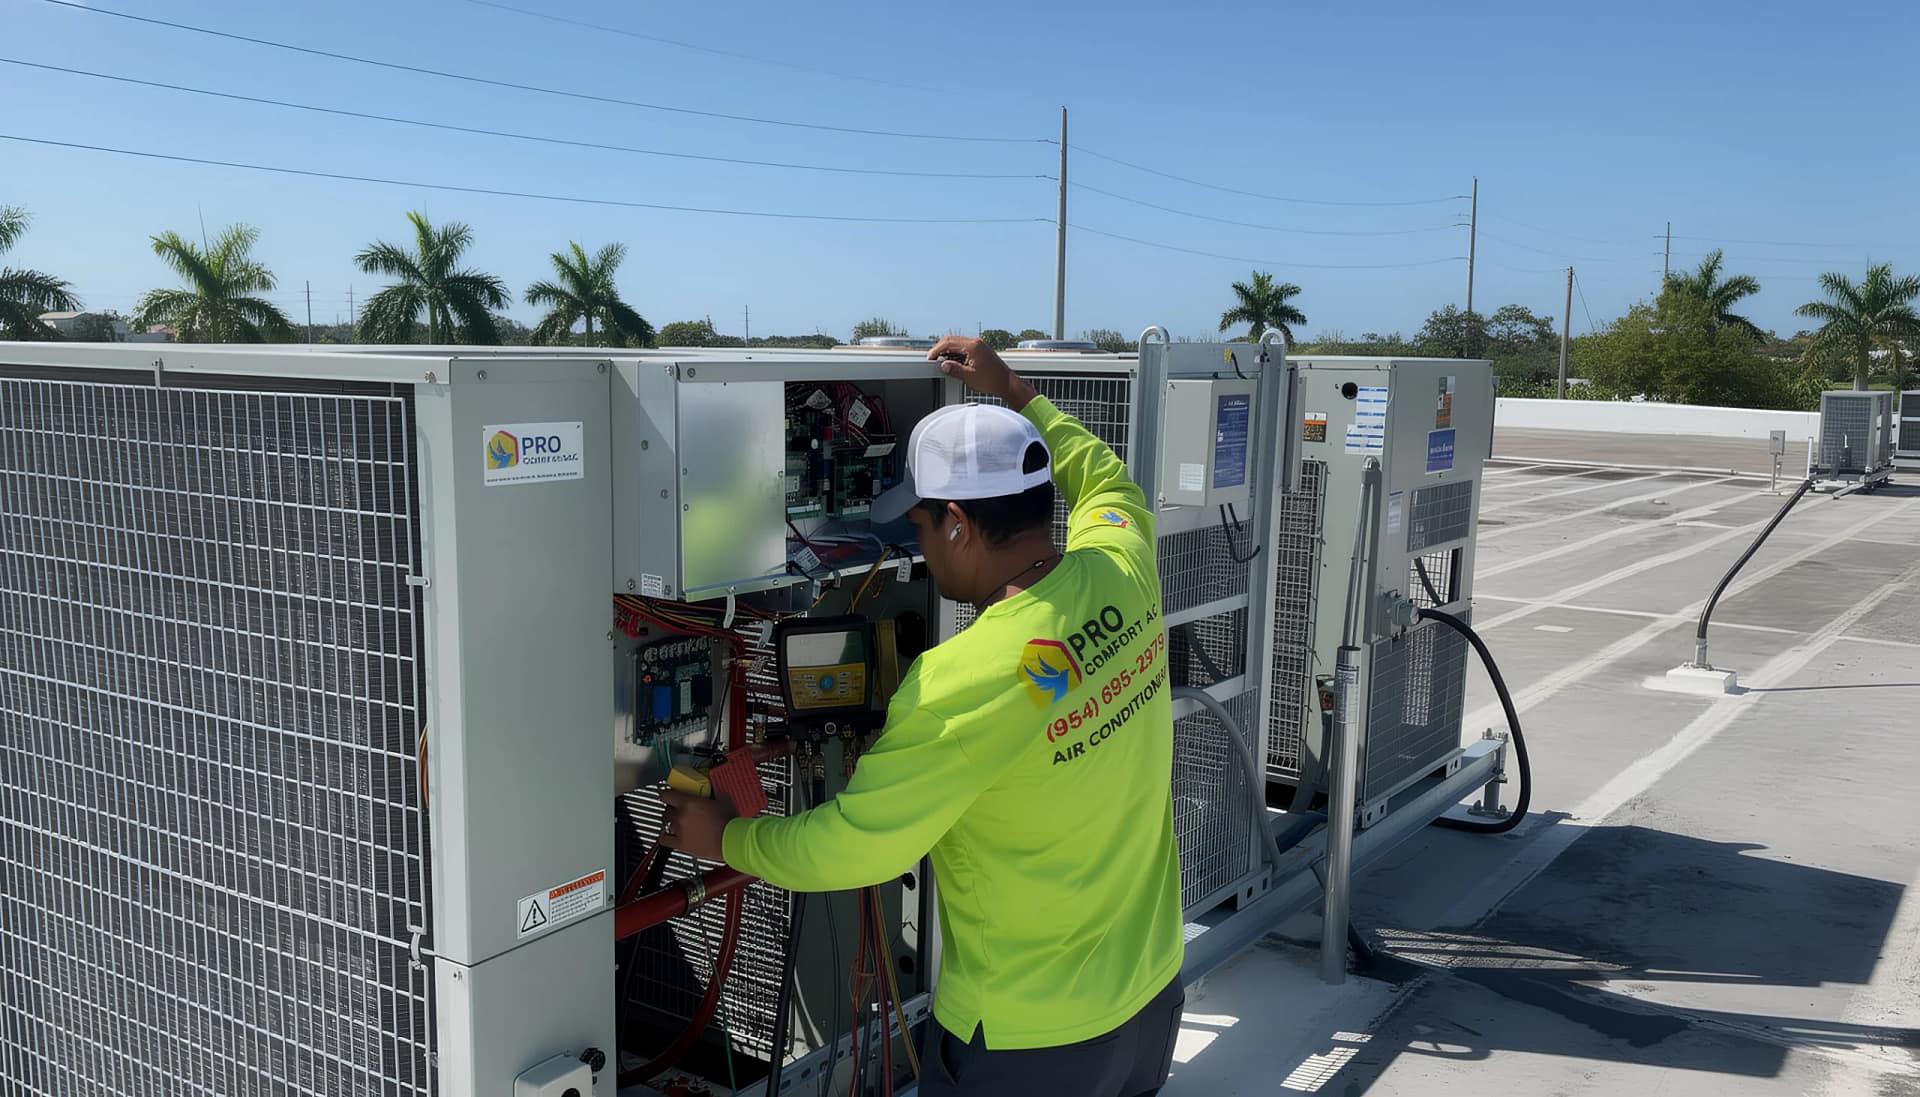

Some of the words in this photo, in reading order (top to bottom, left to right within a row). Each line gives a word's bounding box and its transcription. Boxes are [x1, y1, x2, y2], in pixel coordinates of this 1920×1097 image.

[521, 435, 561, 456] PRO
[1067, 605, 1124, 662] PRO
[1084, 619, 1143, 676] COMFORT
[1046, 696, 1100, 743] (954)
[1101, 632, 1165, 705] 695-2979
[1052, 741, 1086, 766] AIR
